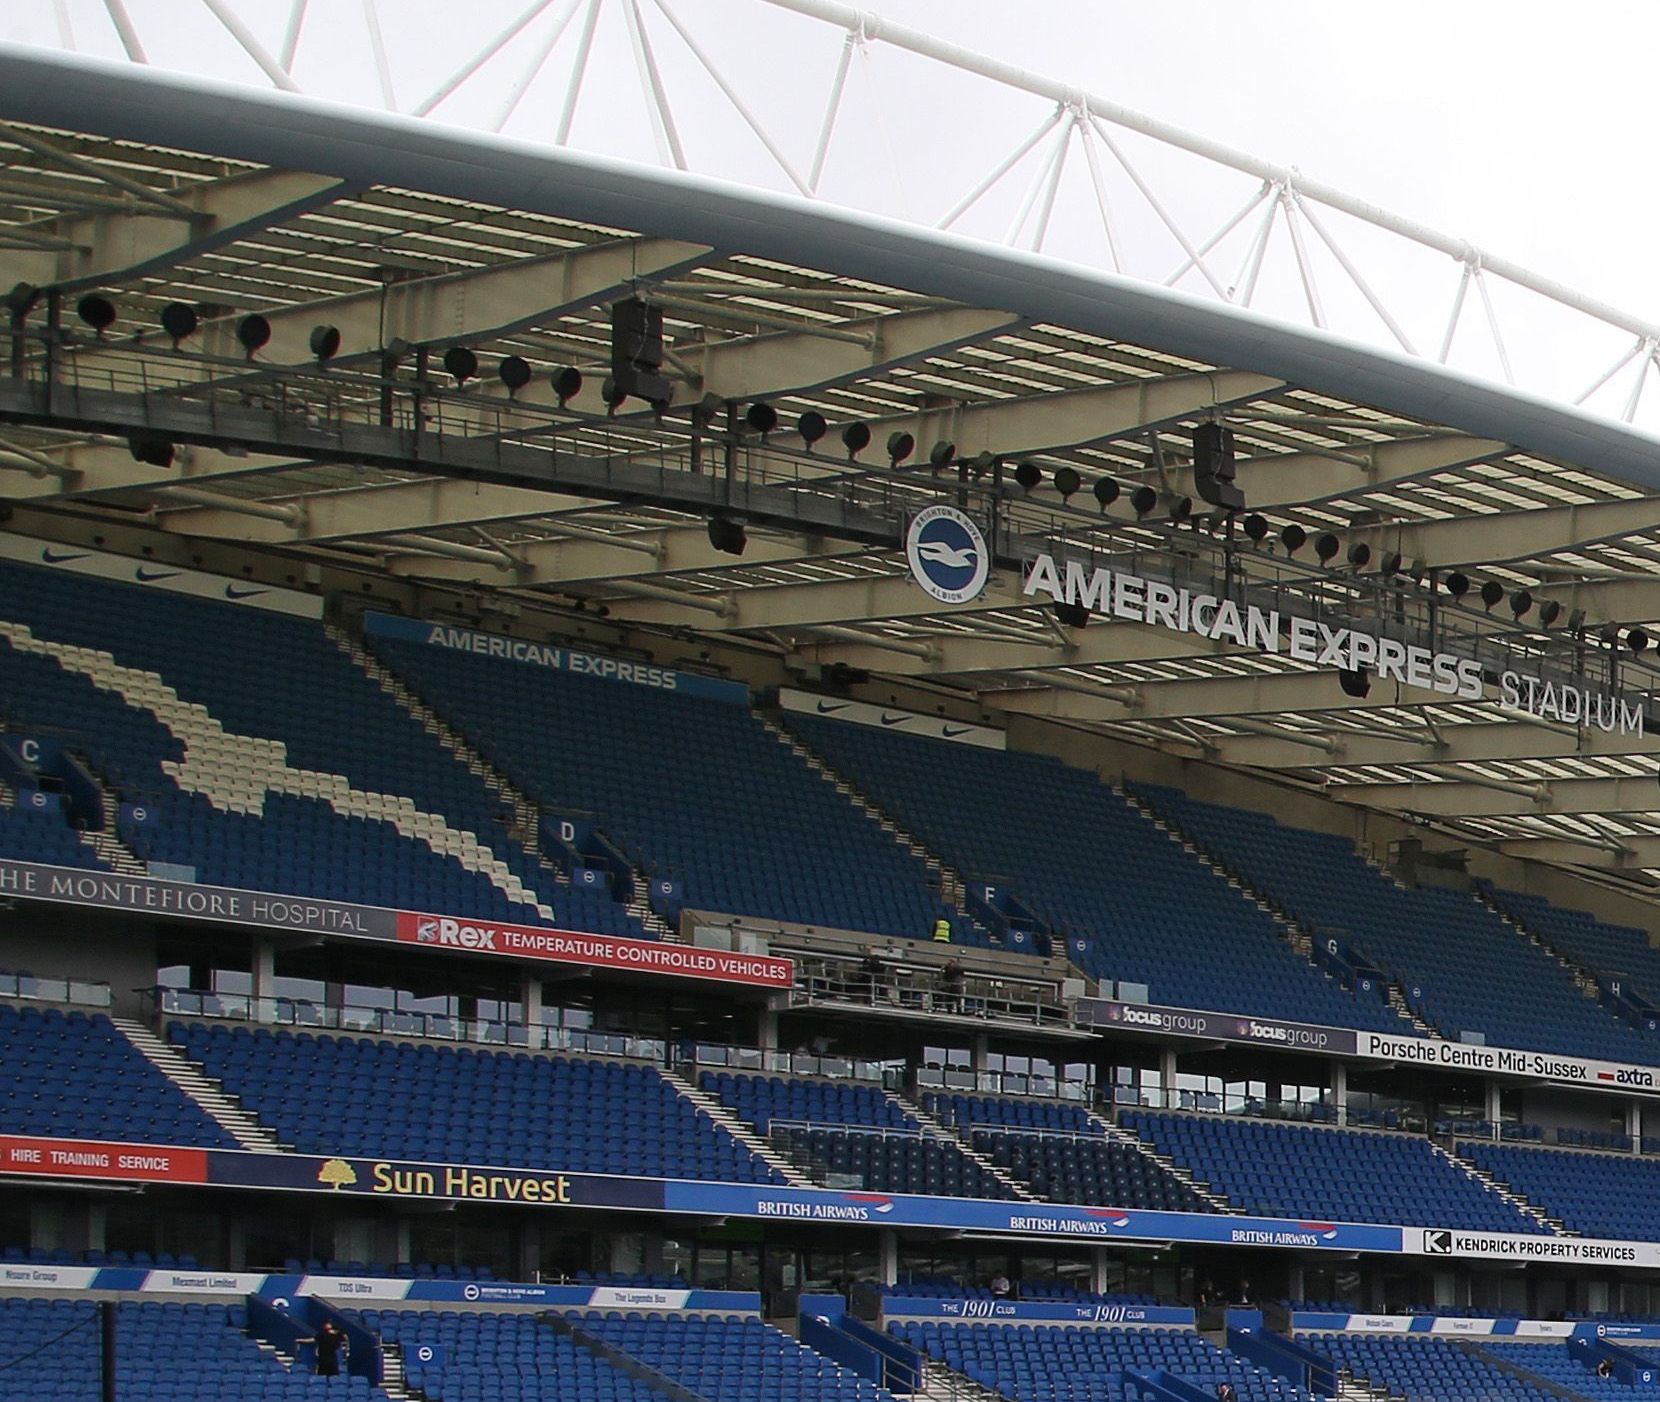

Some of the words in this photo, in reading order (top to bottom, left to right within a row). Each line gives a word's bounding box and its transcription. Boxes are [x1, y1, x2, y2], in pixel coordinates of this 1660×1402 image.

[916, 508, 953, 528] BRIGHTON
[963, 516, 981, 542] HOVE
[931, 587, 963, 601] ALBION
[1024, 553, 1279, 653] AMERICAN
[1290, 618, 1484, 700] EXPRESS
[1500, 669, 1645, 739] STADIUM
[428, 626, 560, 668] AMERICAN
[568, 653, 677, 690] EXPRESS
[22, 740, 39, 762] C
[561, 822, 574, 841] D
[0, 867, 37, 892] HE
[50, 874, 241, 917] MONTEFIORE
[252, 900, 369, 932] HOSPITAL
[985, 886, 995, 903] F
[440, 919, 496, 950] Rex
[502, 930, 614, 959] TEMPERATURE
[616, 946, 717, 971] CONTROLLED
[719, 957, 787, 980] VEHICLES
[1369, 1035, 1436, 1062] Porsche
[1440, 1044, 1494, 1068] Centre
[1498, 1051, 1587, 1080] Mid-Sussex
[1616, 1067, 1653, 1087] axtra
[11, 1148, 41, 1164] HIRE
[51, 1151, 109, 1168] TRAINING
[118, 1156, 170, 1171] SERVICE
[373, 1163, 434, 1195] Sun
[445, 1167, 571, 1203] Harvest
[757, 1200, 811, 1217] BRITISH
[812, 1203, 869, 1221] AIRWAYS
[1010, 1216, 1057, 1232] BRITISH
[1058, 1219, 1107, 1235] AIRWAYS
[1232, 1229, 1273, 1243] BRITISH
[1274, 1232, 1318, 1246] AIRWAYS
[1456, 1237, 1517, 1253] KENDRICK
[1519, 1241, 1579, 1257] PROPERTY
[1582, 1246, 1636, 1261] SERVICES
[208, 1277, 237, 1288] Limited
[615, 1292, 626, 1302] The
[941, 1303, 958, 1313] THE
[961, 1300, 996, 1318] 1901
[996, 1306, 1016, 1314] CLUB
[1076, 1308, 1092, 1317] THE
[1094, 1305, 1127, 1322] 1901
[1127, 1310, 1145, 1319] CLUB
